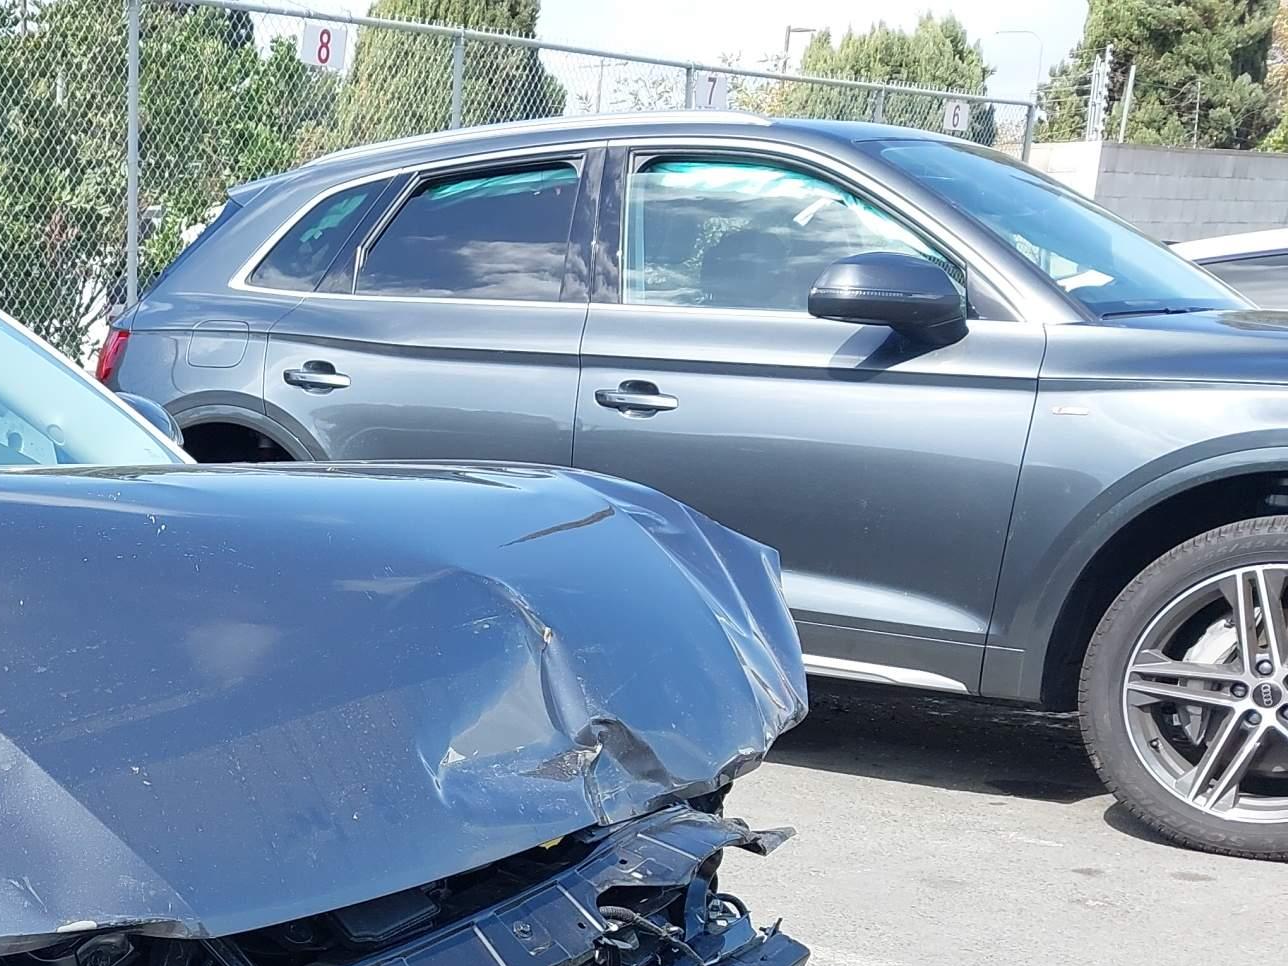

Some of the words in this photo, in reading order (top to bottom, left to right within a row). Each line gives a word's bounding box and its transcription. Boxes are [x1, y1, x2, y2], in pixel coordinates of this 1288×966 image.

[317, 28, 331, 64] 8
[707, 77, 718, 105] 7
[952, 104, 961, 128] 6
